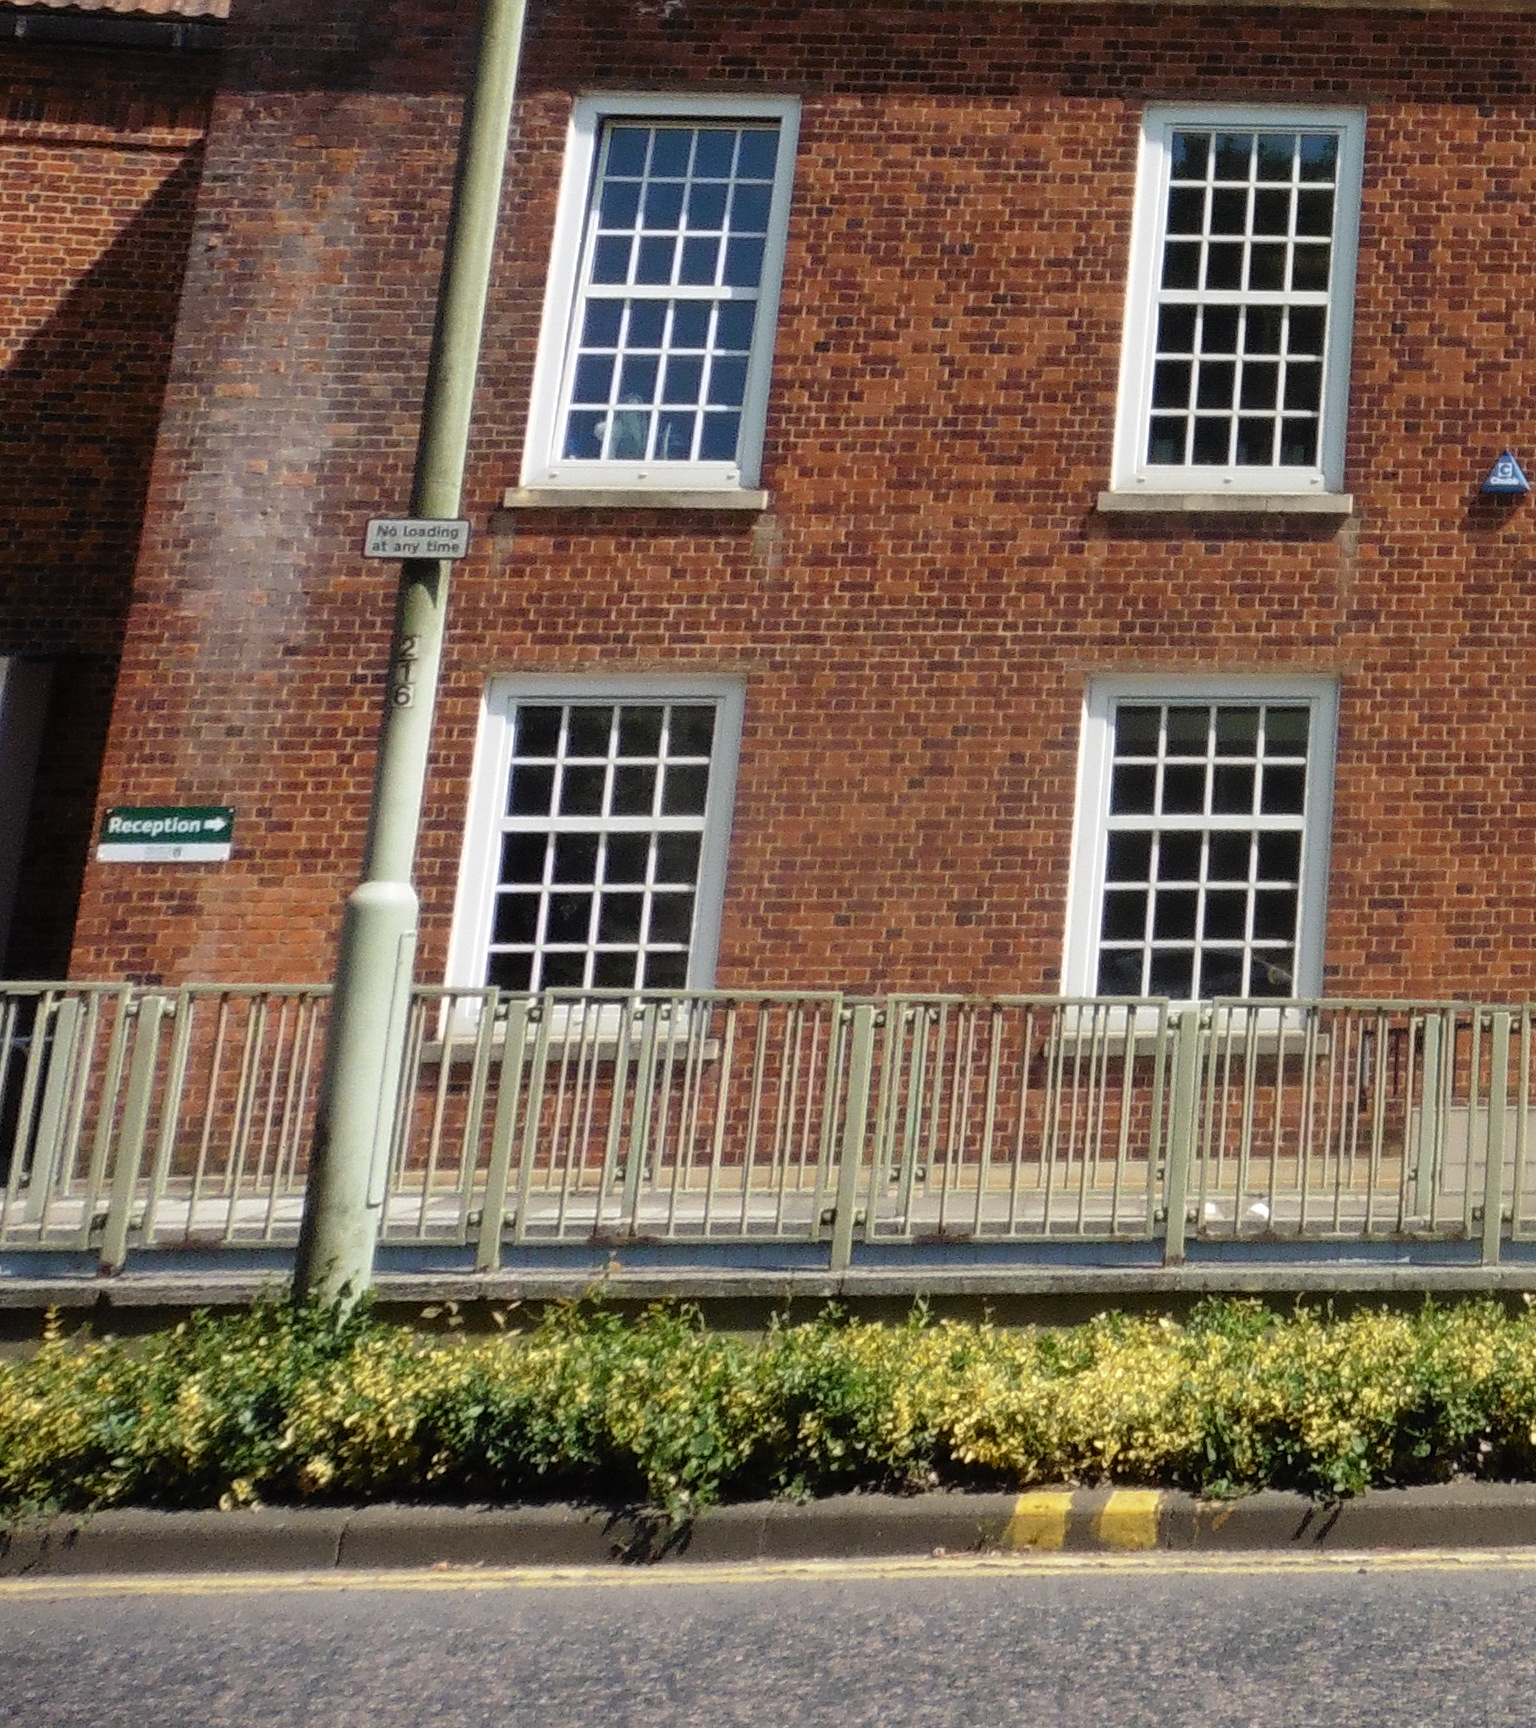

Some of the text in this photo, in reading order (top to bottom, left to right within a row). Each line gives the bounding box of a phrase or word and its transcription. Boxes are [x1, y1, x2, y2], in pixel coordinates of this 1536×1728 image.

[377, 525, 459, 540] No loading
[372, 541, 459, 554] at any time
[108, 816, 201, 837] Reception
